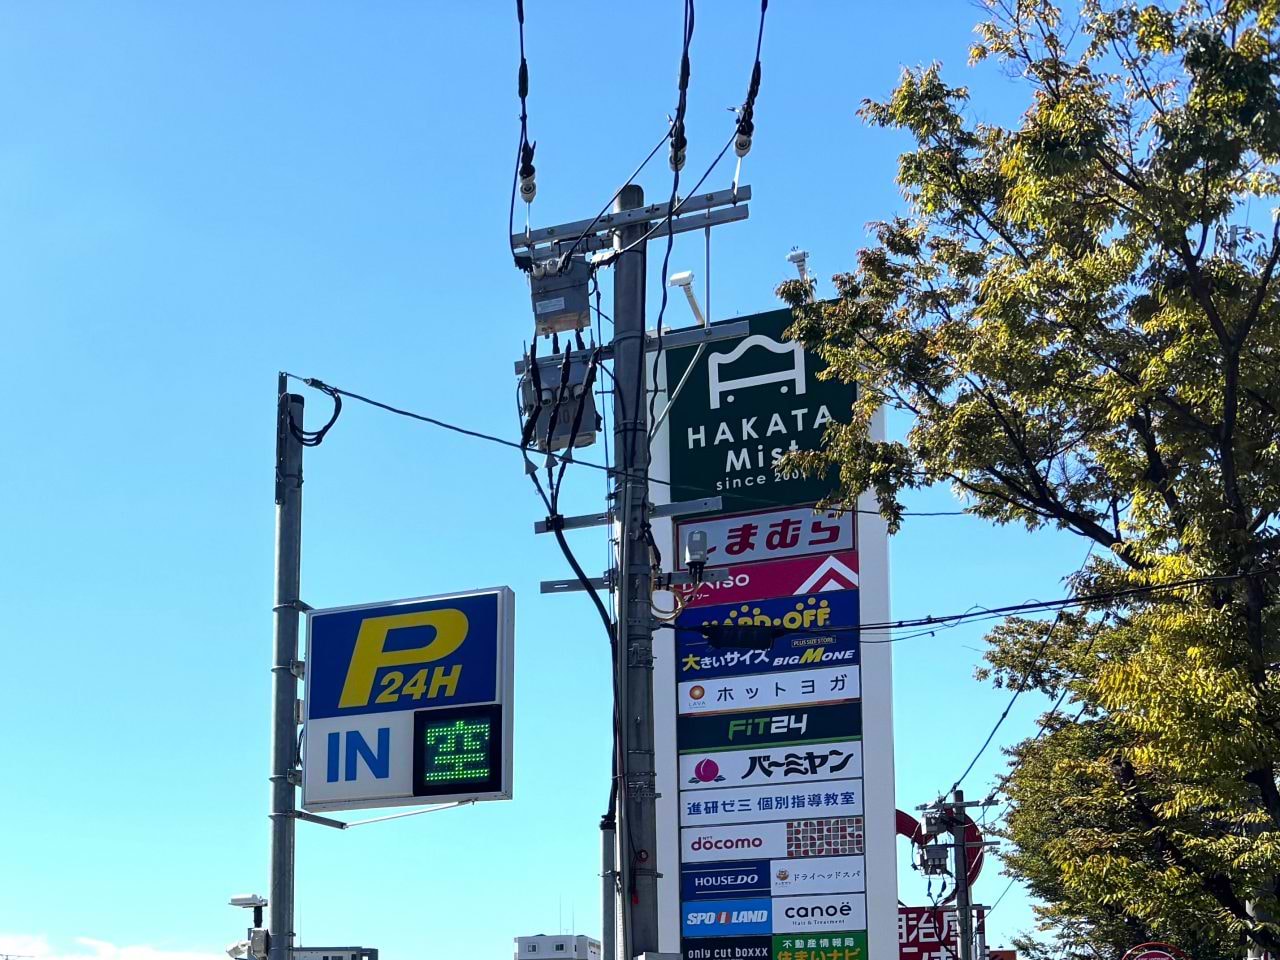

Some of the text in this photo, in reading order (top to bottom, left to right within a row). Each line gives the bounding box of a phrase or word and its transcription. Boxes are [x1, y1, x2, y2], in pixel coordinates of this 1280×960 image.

[687, 405, 833, 449] HAKATA
[716, 474, 766, 490] since
[707, 513, 841, 556] まむら
[338, 608, 469, 708] P
[682, 649, 770, 672] 大きいサイズ
[375, 665, 462, 704] 24H
[717, 674, 848, 702] ホットヨガ
[327, 728, 390, 783] IN
[426, 720, 489, 781] 空
[741, 749, 854, 780] バーミヤン
[758, 791, 855, 811] 個別指導教室
[691, 836, 763, 851] docomo
[785, 902, 852, 918] canoë
[714, 948, 732, 958] cut
[782, 937, 855, 949] 不動産情報局
